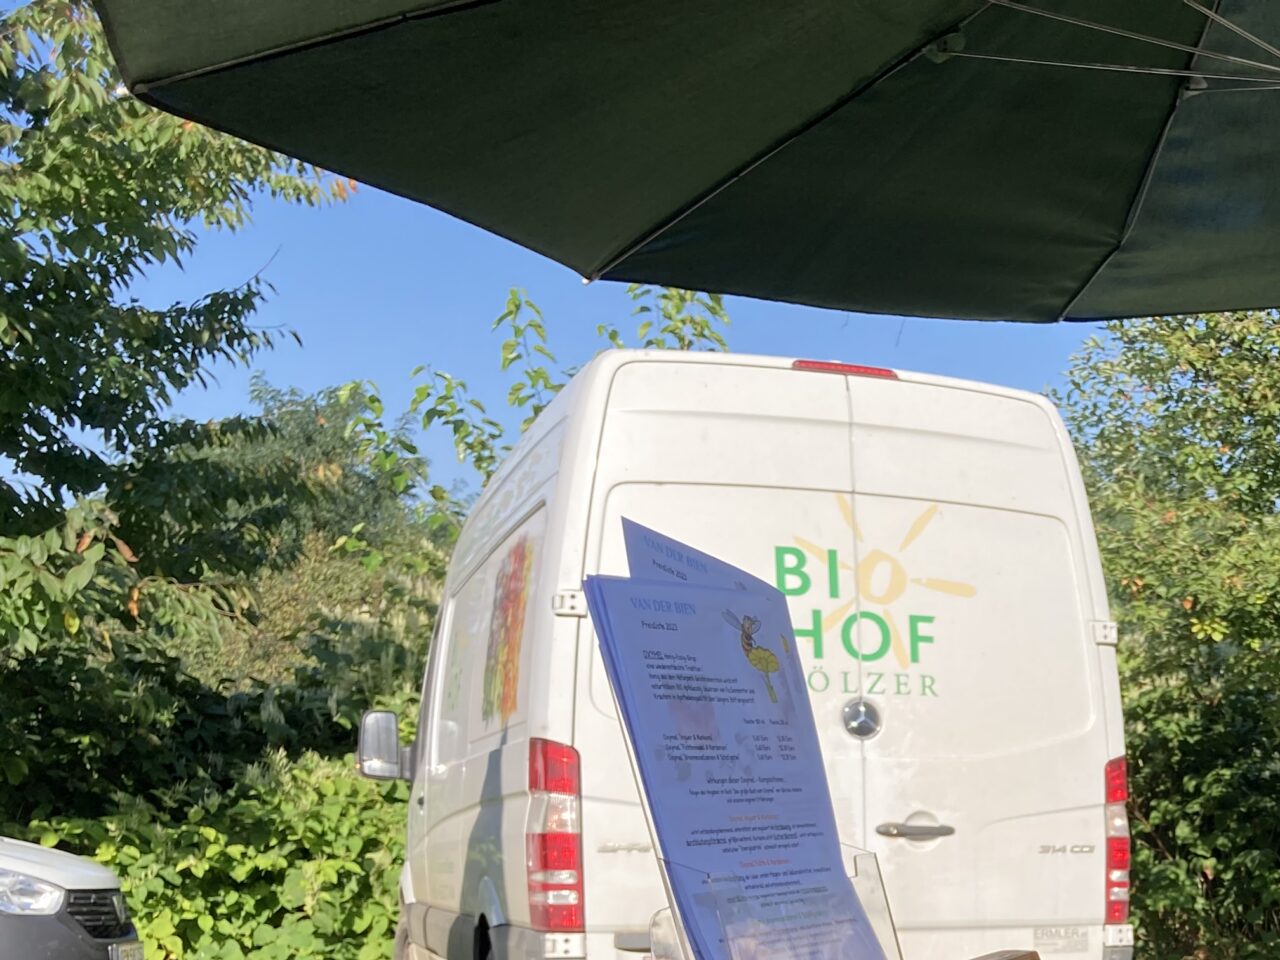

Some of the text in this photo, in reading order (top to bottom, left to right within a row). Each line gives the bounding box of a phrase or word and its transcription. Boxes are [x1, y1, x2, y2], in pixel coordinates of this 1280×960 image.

[629, 596, 697, 615] VAN DER BIEN
[794, 608, 936, 664] HOF
[807, 665, 939, 697] ÖLZER
[1038, 844, 1096, 854] 314 CDI
